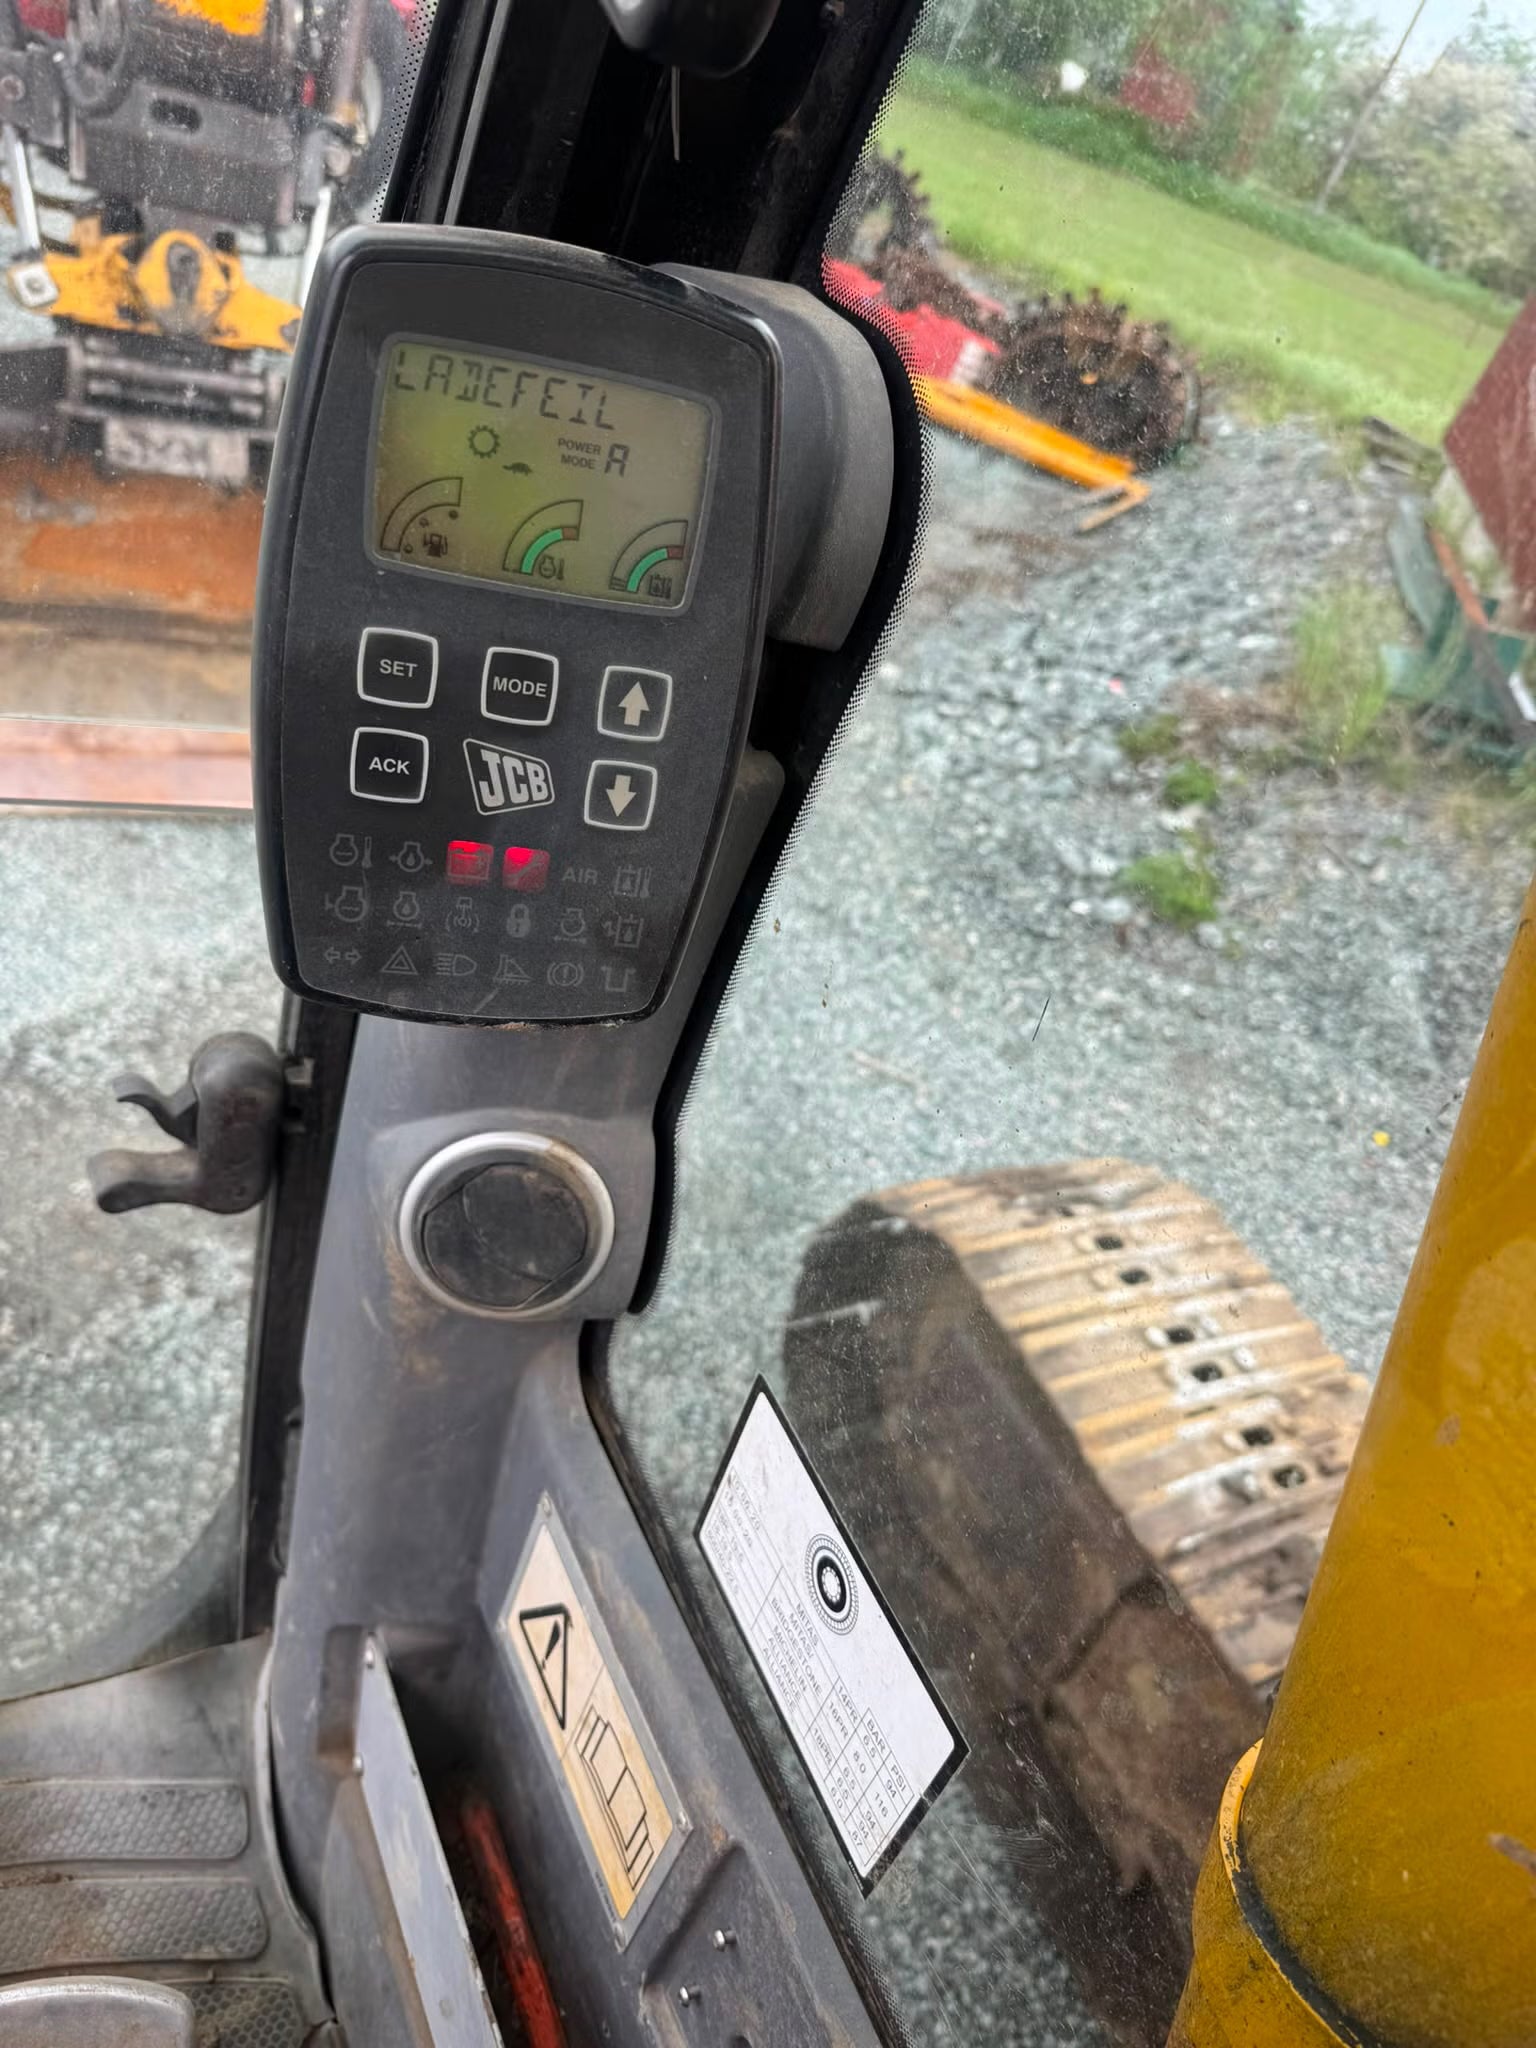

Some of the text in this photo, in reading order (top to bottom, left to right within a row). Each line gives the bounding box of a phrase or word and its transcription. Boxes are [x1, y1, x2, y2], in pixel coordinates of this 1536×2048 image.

[393, 351, 615, 431] LADEFEIL
[557, 437, 602, 455] POWER
[560, 454, 597, 470] MODE
[604, 443, 630, 477] A
[379, 658, 418, 679] SET
[492, 676, 548, 698] MODE
[368, 755, 411, 775] ACK
[479, 748, 549, 808] JCB
[562, 867, 599, 886] AIR
[762, 1643, 795, 1713] ALLIANCE
[771, 1595, 822, 1699] BRIDGESTONE
[773, 1623, 807, 1693] MICHELIN
[864, 1808, 876, 1830] 94
[795, 1601, 818, 1647] MITAS
[837, 1683, 858, 1724] 14PR
[885, 1778, 897, 1799] 94
[768, 1633, 801, 1703] ALLIANCE
[858, 1819, 868, 1839] 94
[828, 1699, 848, 1739] 16PR
[873, 1789, 888, 1818] 116
[866, 1717, 906, 1793] BAR PSI
